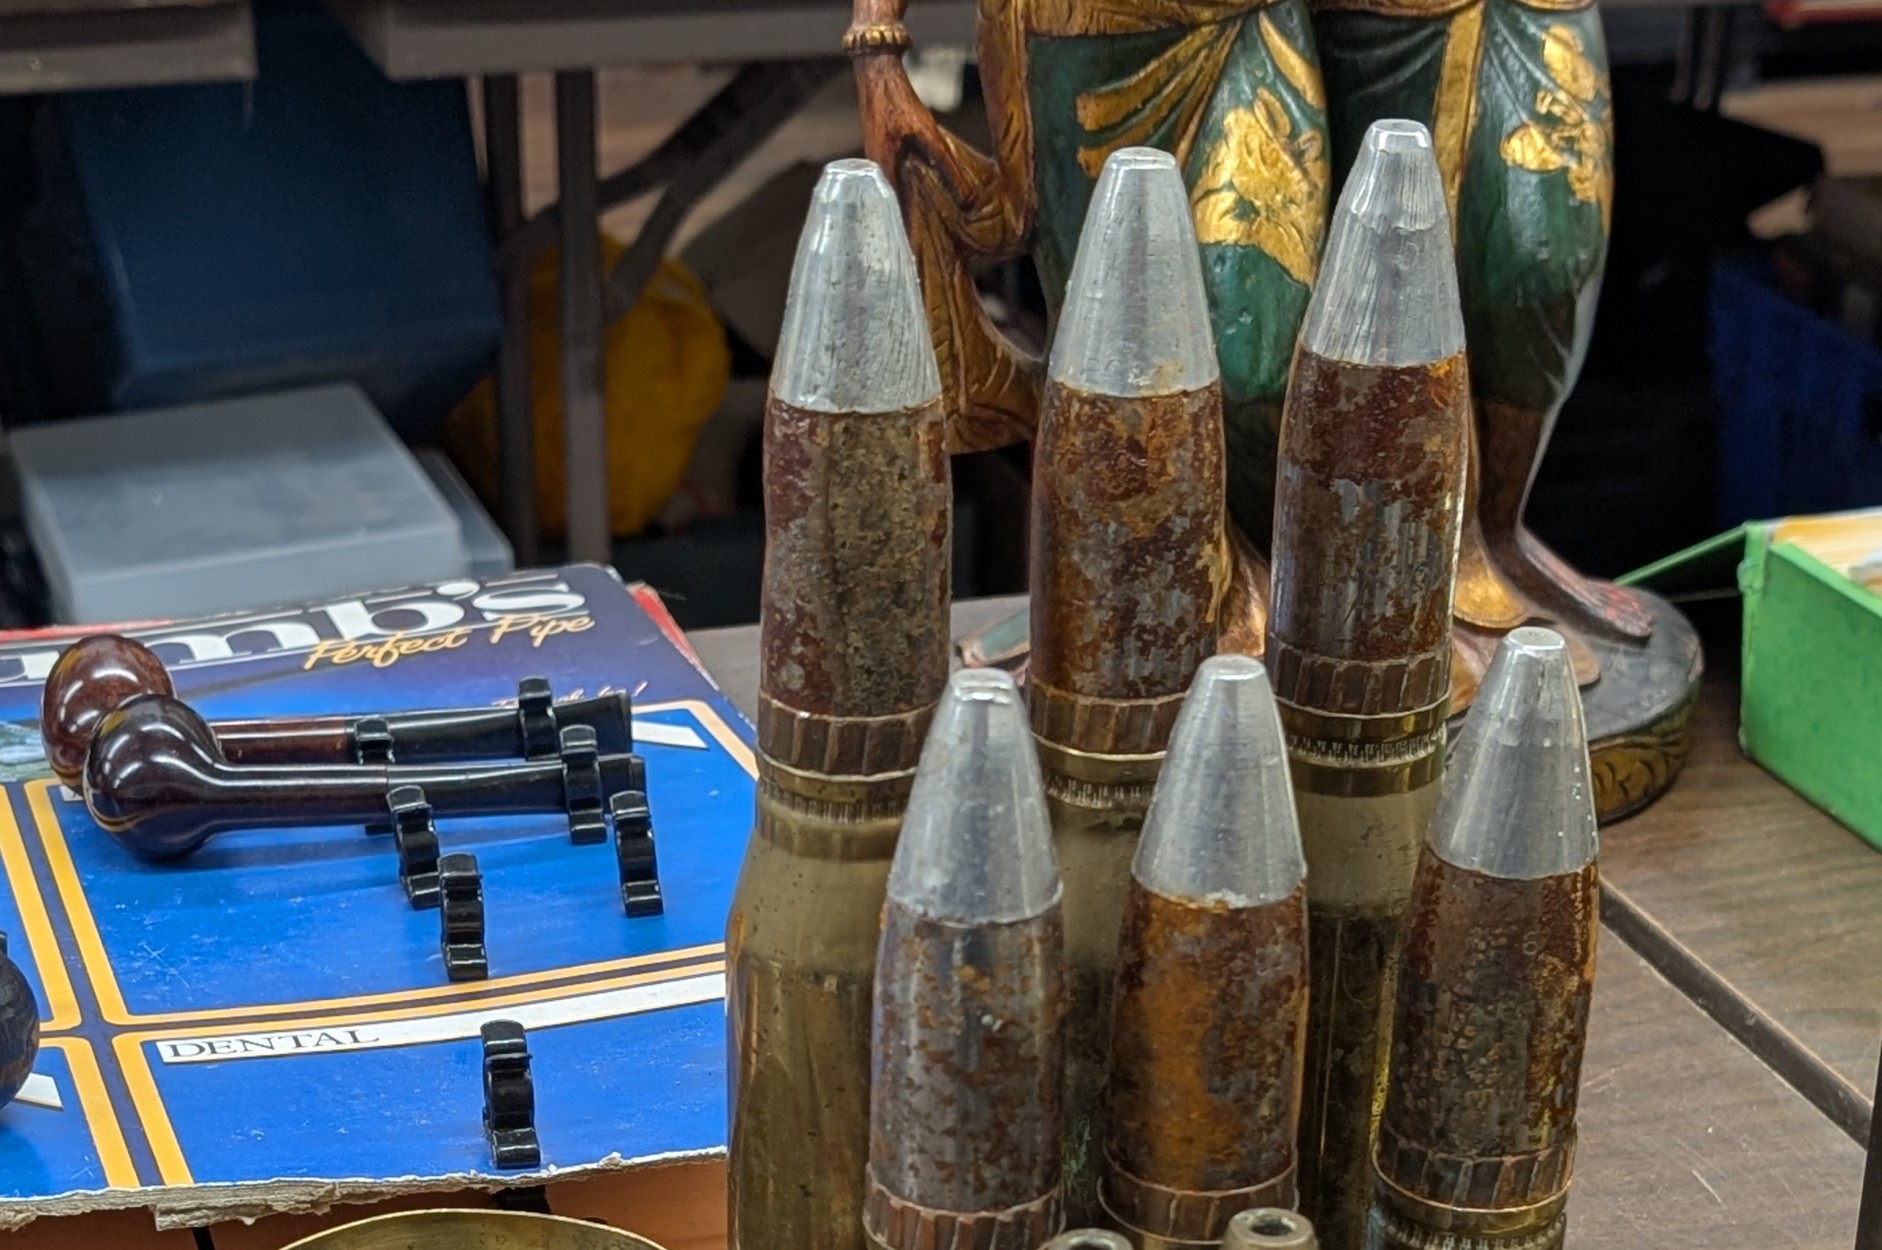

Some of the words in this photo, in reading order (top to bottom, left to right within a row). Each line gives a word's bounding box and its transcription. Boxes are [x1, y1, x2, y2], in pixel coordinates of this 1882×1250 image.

[303, 627, 472, 671] Perfect
[490, 613, 595, 648] Pipe
[166, 1029, 380, 1058] DENTAL
